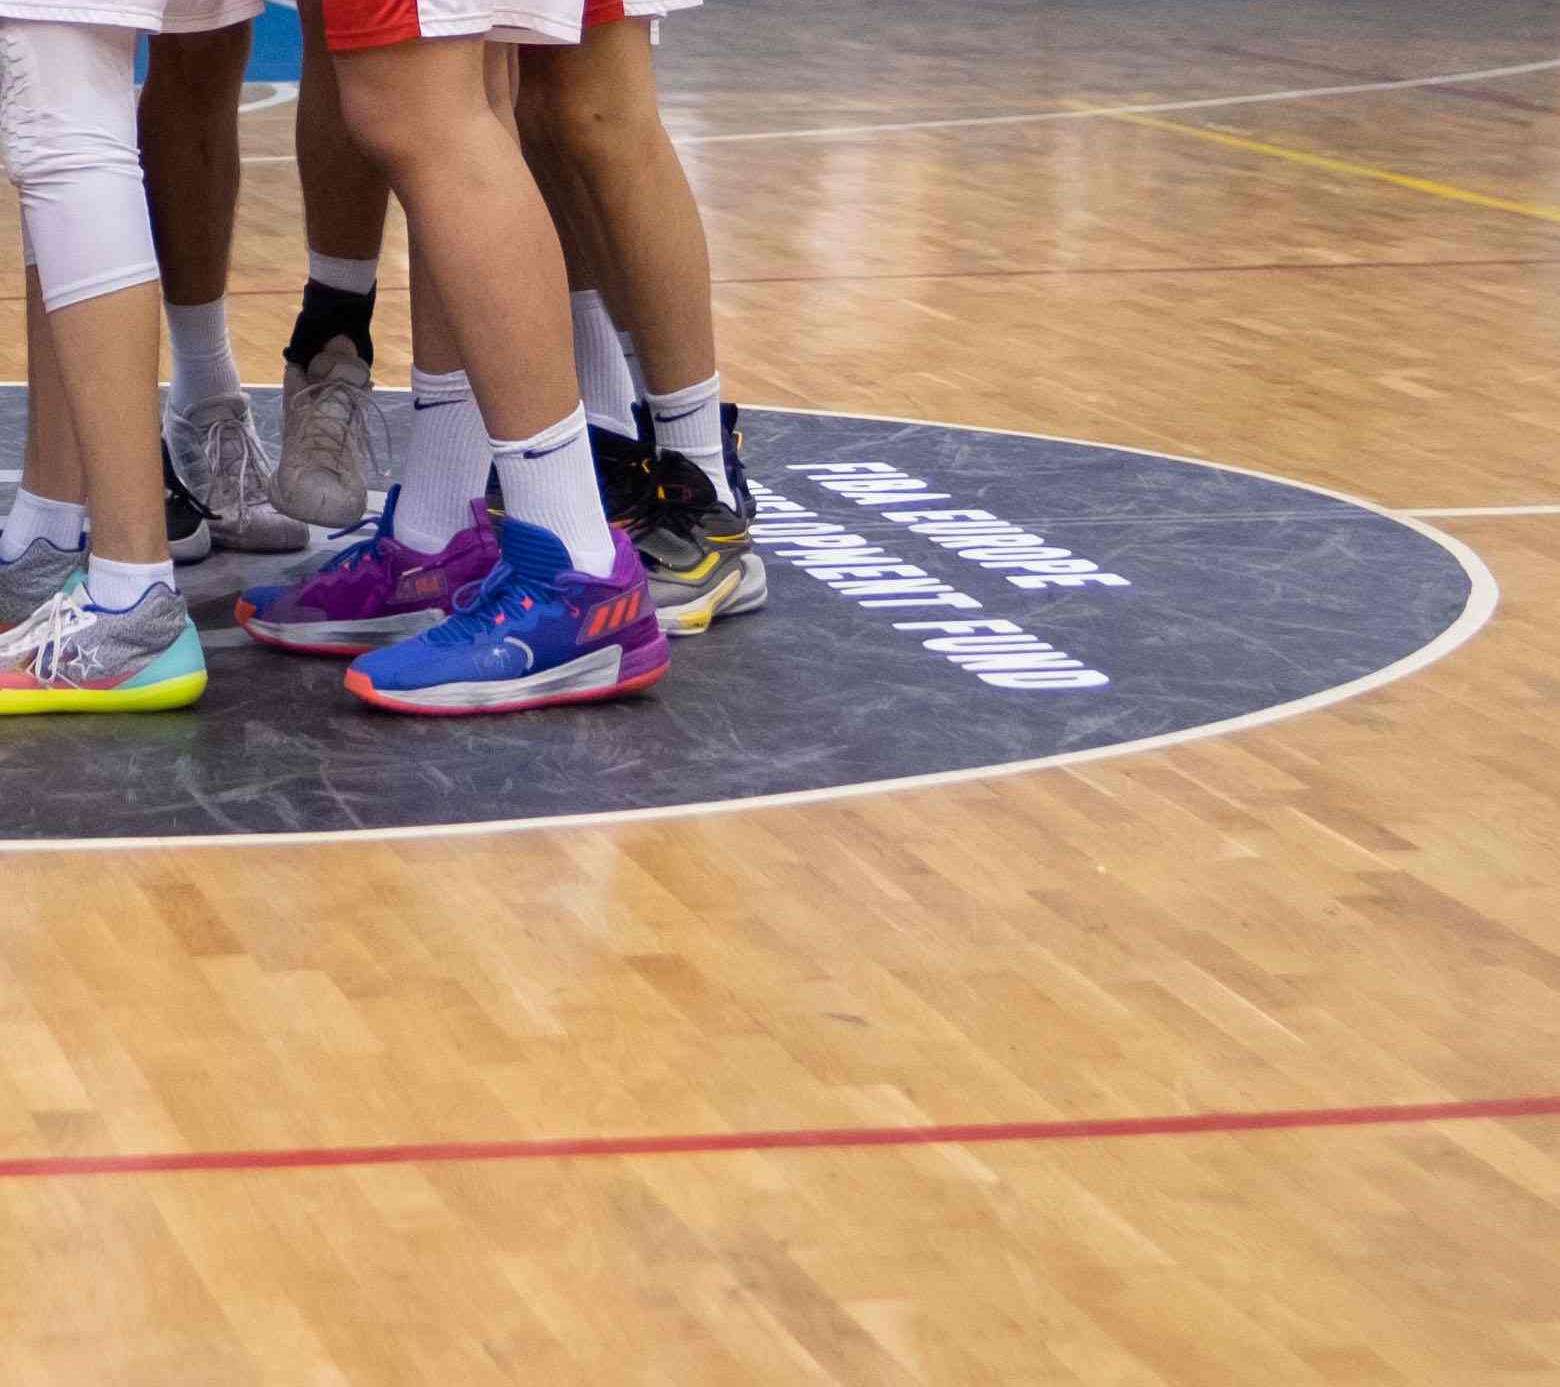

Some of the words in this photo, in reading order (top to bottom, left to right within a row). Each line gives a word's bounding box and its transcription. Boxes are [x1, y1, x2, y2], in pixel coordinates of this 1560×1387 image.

[785, 461, 953, 505] FIBA
[880, 508, 1133, 590] EUROPE
[892, 618, 1111, 690] FUND
